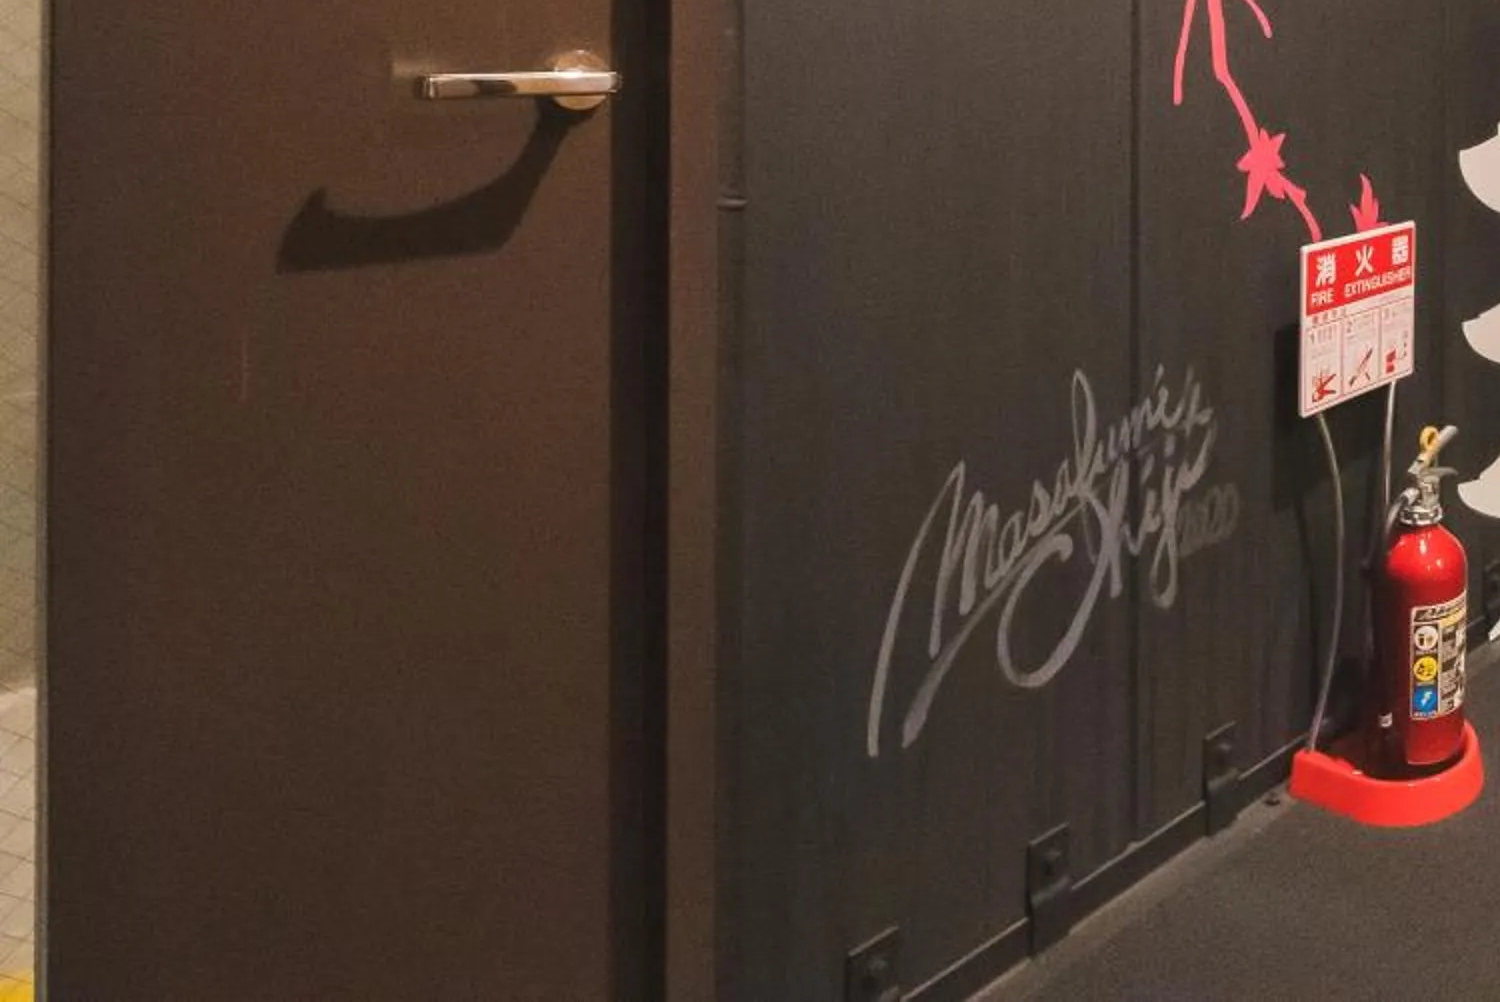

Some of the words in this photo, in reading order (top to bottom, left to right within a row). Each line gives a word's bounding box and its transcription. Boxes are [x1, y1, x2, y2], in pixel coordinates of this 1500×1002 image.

[1315, 234, 1410, 287] 消火器
[1311, 287, 1335, 307] FIRE
[1344, 265, 1411, 298] EXTINGUISHER
